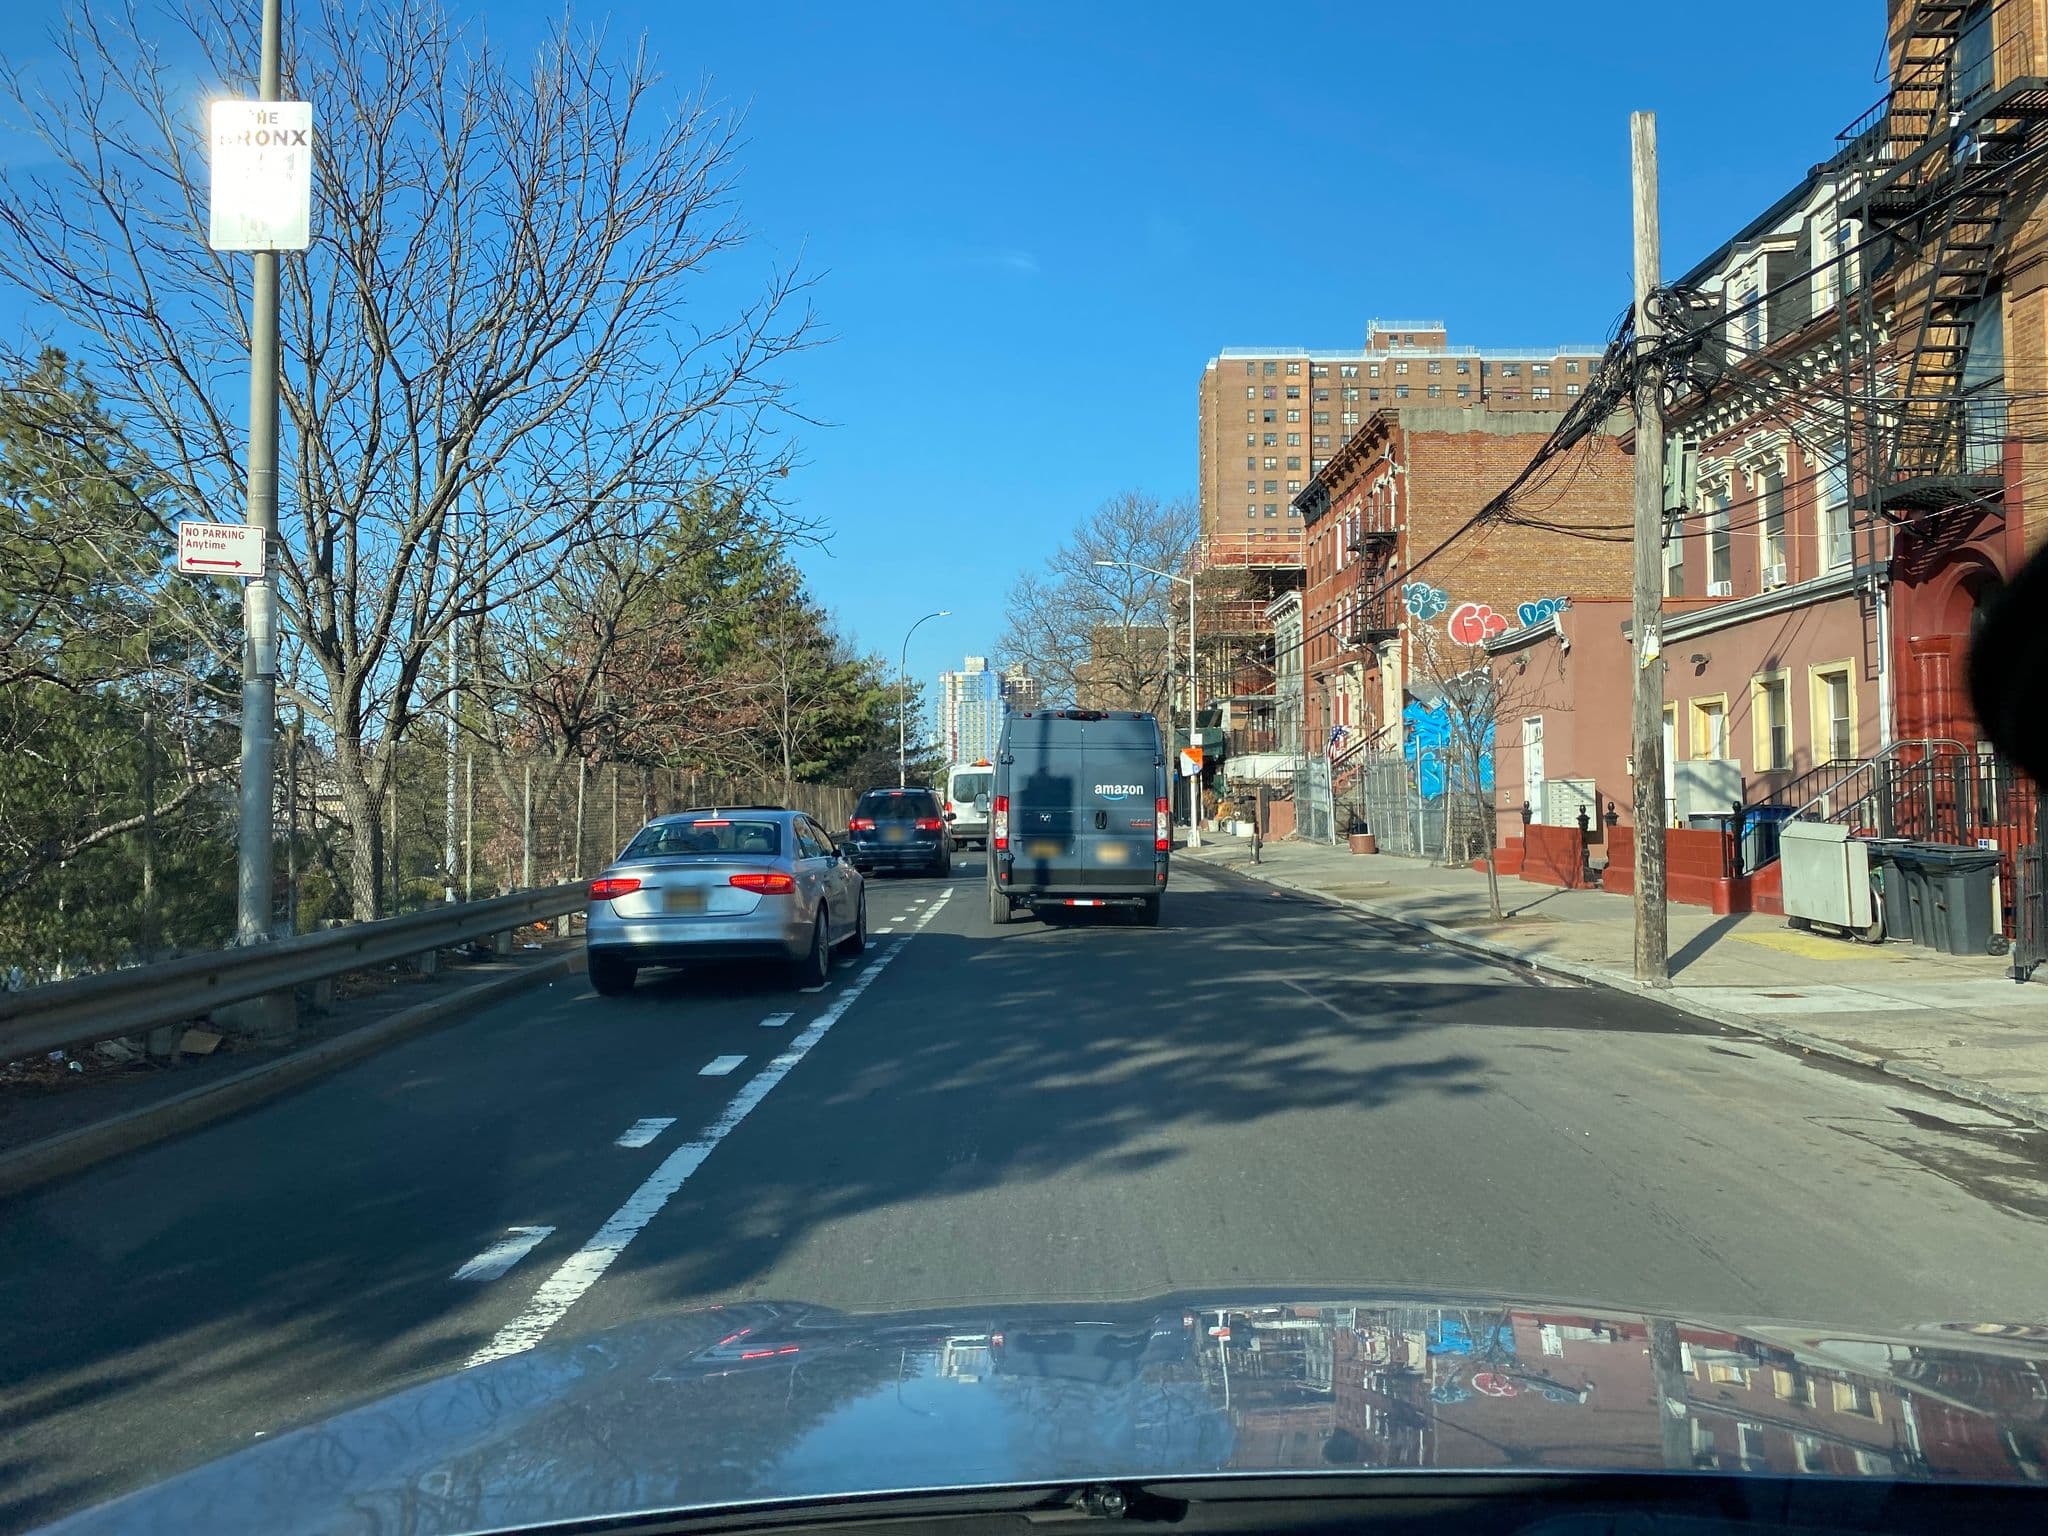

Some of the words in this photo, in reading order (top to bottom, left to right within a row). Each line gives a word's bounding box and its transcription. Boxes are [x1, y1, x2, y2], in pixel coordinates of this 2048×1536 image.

[220, 130, 308, 146] RONX
[185, 527, 199, 537] NO
[202, 528, 245, 540] PARKING
[186, 538, 226, 550] Anytime
[1094, 783, 1144, 796] amazon
